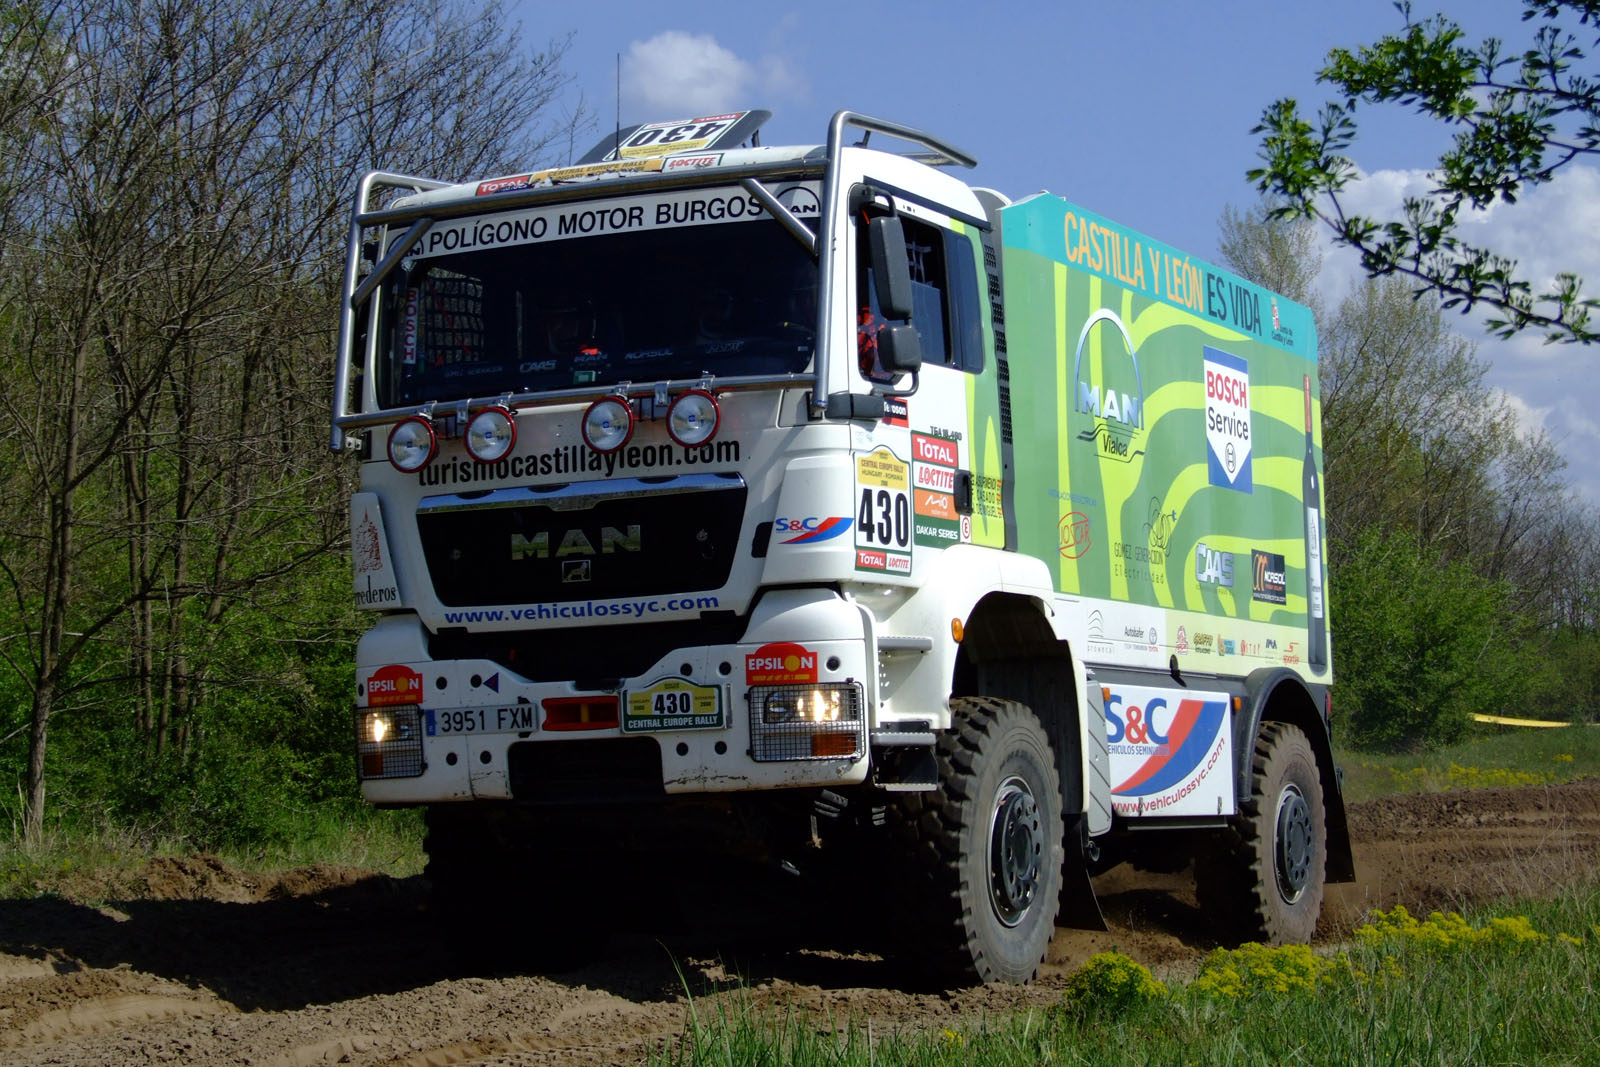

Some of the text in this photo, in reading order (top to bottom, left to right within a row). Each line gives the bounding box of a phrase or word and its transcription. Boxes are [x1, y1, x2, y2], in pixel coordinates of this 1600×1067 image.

[627, 122, 728, 148] 430
[622, 160, 649, 168] RALLY
[668, 156, 716, 170] LOCTITE
[785, 204, 817, 214] AN
[429, 195, 764, 253] POLÍGONO MOTOR BURGOS
[1064, 211, 1262, 337] CASTILLA Y LEÓN ES VIDA
[402, 289, 417, 361] BOSCH
[1206, 370, 1248, 409] BOSCH
[1080, 381, 1140, 429] MAN
[1207, 406, 1249, 441] Service
[916, 438, 954, 463] TOTAL
[1103, 433, 1128, 457] Vialca
[417, 440, 740, 487] turismocastillayleon.com
[918, 466, 955, 490] LOCTITE
[775, 517, 818, 532] S&C
[858, 488, 909, 548] 430
[511, 525, 642, 560] MAN
[915, 524, 959, 540] DAKAR SERIES
[859, 553, 910, 570] TOTAL LOCTITE
[1196, 542, 1235, 588] CAAS
[1263, 570, 1287, 585] NORSOL
[444, 594, 720, 624] www.vehiculossyc.com
[654, 692, 691, 714] 430
[440, 707, 533, 733] 3951 FXM
[628, 716, 718, 729] CENTRAL EUROPE RALLY
[1104, 693, 1170, 746] S&C
[1107, 744, 1137, 756] EHICULOS
